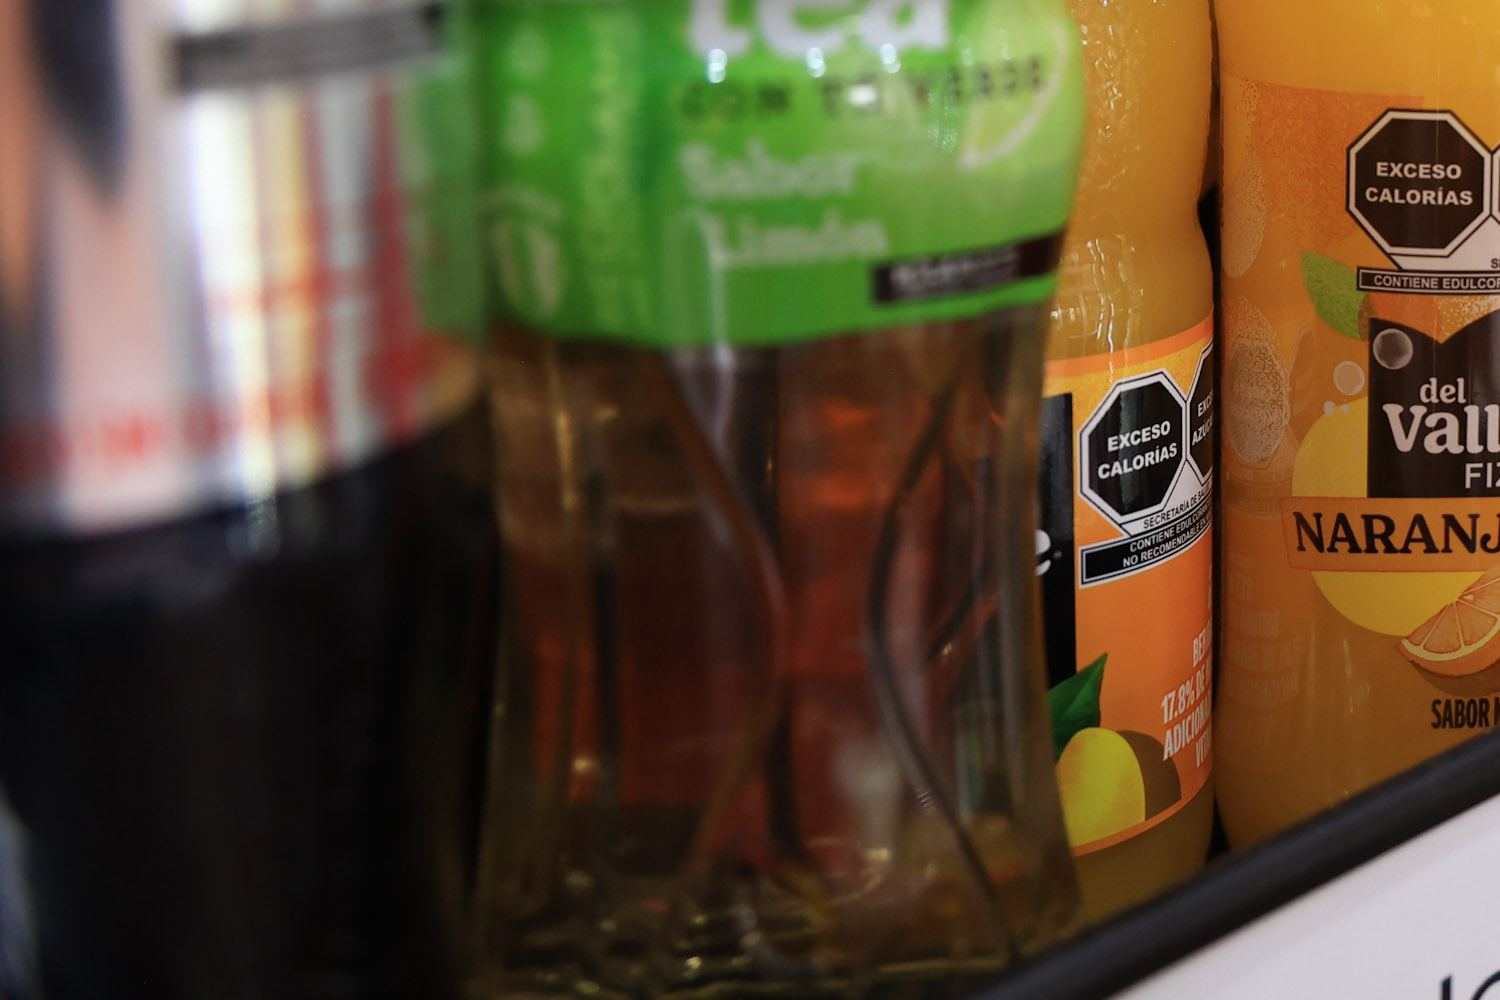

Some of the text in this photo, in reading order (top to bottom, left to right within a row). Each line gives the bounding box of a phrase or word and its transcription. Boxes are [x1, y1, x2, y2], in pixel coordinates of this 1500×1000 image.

[1375, 161, 1462, 180] EXCESO
[1364, 187, 1474, 206] CALORÍAS
[1373, 274, 1439, 290] CONTIENE
[1419, 377, 1467, 404] del
[1107, 420, 1171, 452] EXCESO
[1097, 442, 1178, 480] CALORÍAS
[1143, 499, 1190, 530] SECRETARÍA
[1190, 494, 1199, 507] DE
[1122, 554, 1139, 569] NO
[1140, 525, 1200, 563] RECOMENDABLE
[1129, 524, 1175, 553] CONTIENE
[1161, 676, 1195, 724] 17.8%
[1431, 698, 1490, 729] SABOR
